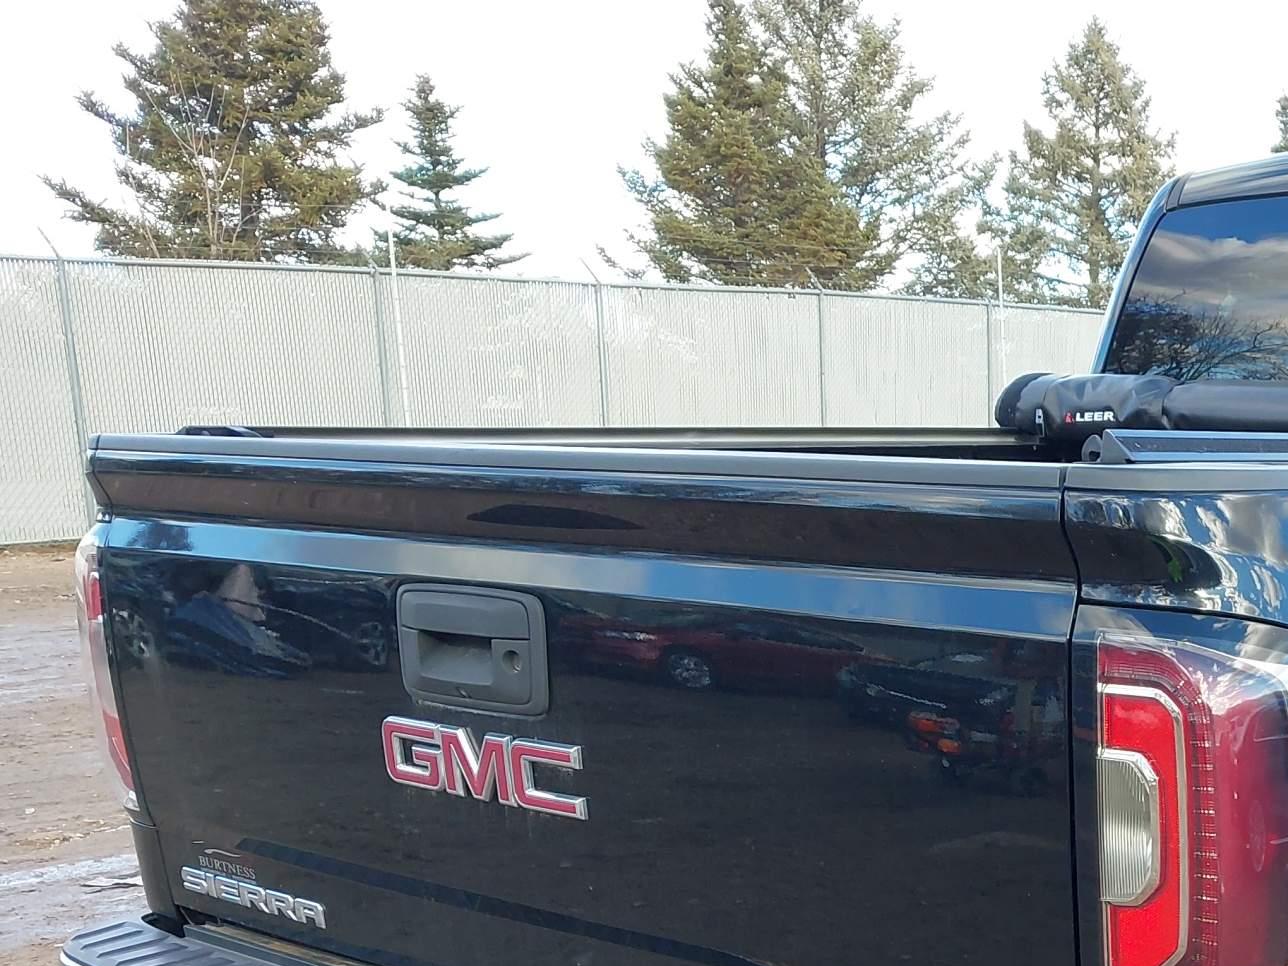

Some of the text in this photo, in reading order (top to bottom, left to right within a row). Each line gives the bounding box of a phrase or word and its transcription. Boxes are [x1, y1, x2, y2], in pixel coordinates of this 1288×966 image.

[1075, 410, 1114, 422] LEER
[381, 715, 589, 820] GMC
[198, 855, 256, 880] BURTNESS
[181, 866, 327, 930] SIERRA
